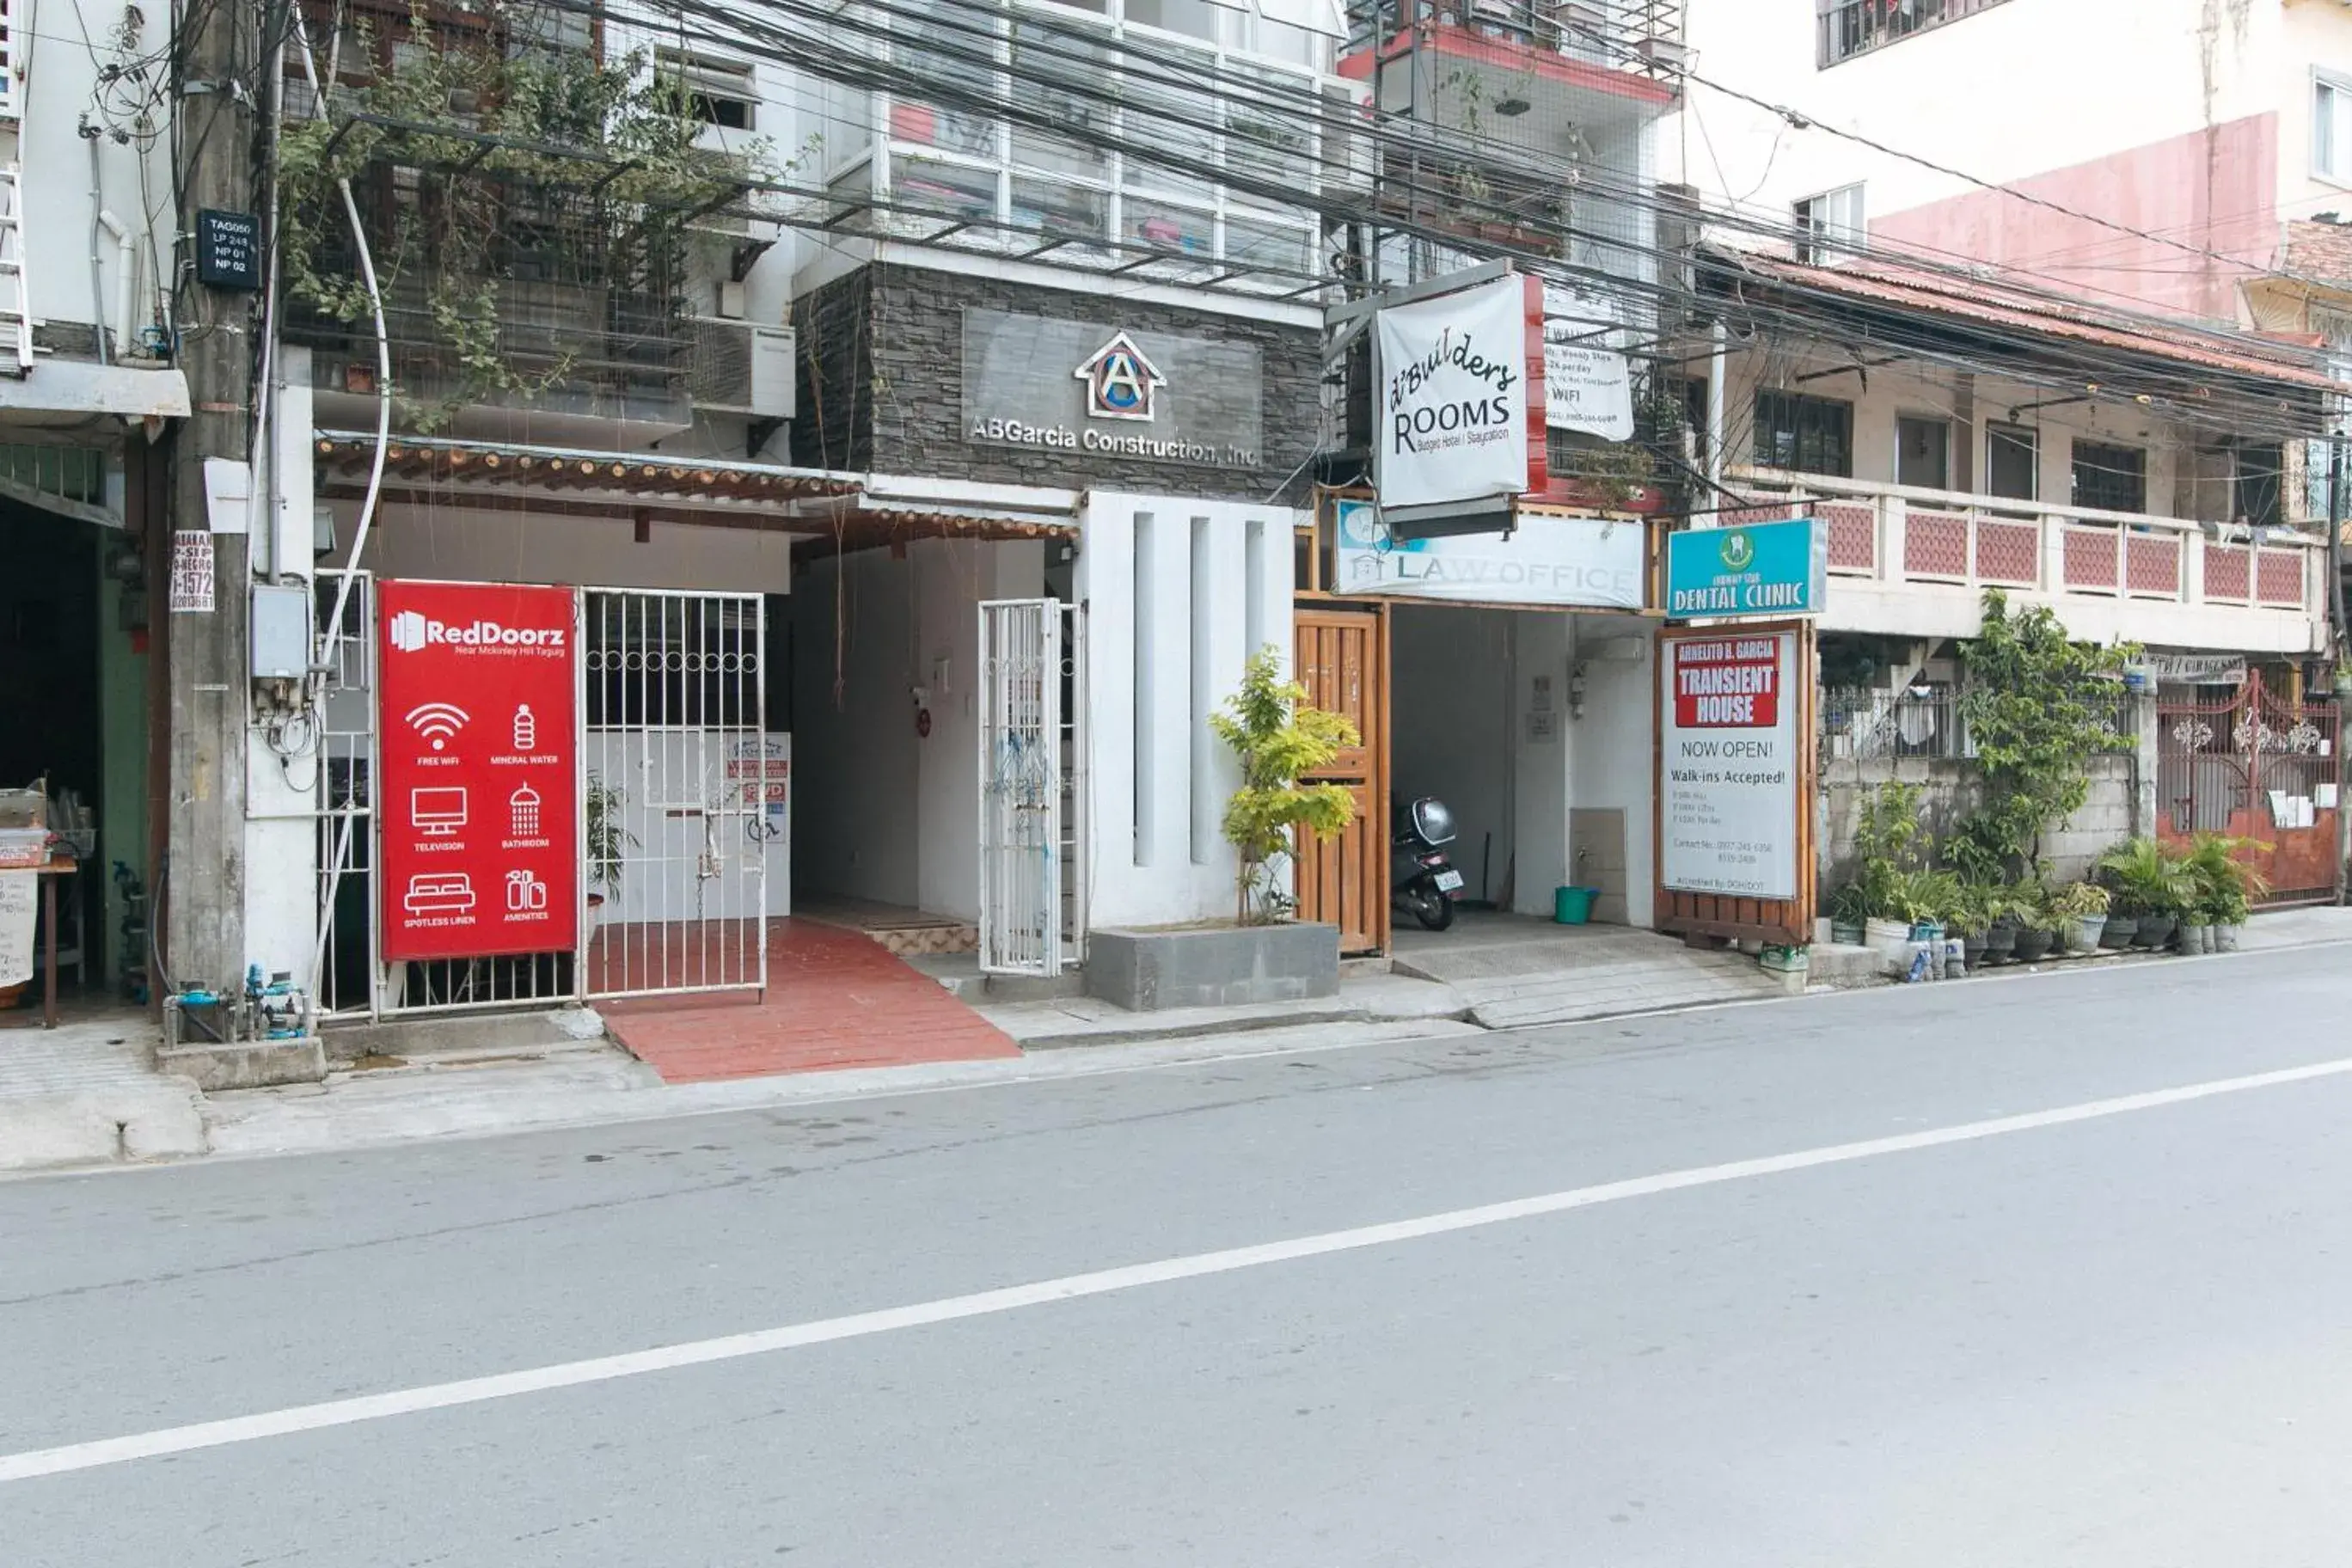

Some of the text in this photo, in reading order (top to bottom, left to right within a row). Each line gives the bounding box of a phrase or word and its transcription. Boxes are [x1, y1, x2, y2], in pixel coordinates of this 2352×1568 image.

[216, 246, 245, 259] NP 01
[216, 258, 246, 273] NP 02
[970, 415, 1076, 448] ABGarcia
[1395, 396, 1510, 454] ROOMS
[1398, 555, 1635, 593] LAW OFFICE
[1675, 582, 1803, 611] DENTAL CLINIC
[427, 621, 565, 646] RedDoorz
[455, 646, 478, 655] Near
[1736, 640, 1774, 659] GARCIA
[1679, 665, 1774, 695] TRANSIENT
[1697, 695, 1754, 724] HOUSE
[1681, 741, 1773, 758] NOW OPEN!
[417, 756, 438, 766] FREE
[490, 755, 558, 765] MINERAL WATER
[1671, 769, 1785, 786] Walk-ins Accepted!
[414, 842, 465, 853] TELEVISION
[502, 839, 549, 849] BATHROOM
[404, 916, 476, 928] SPOTLESS LINEN
[503, 912, 548, 922] AMENITIES
